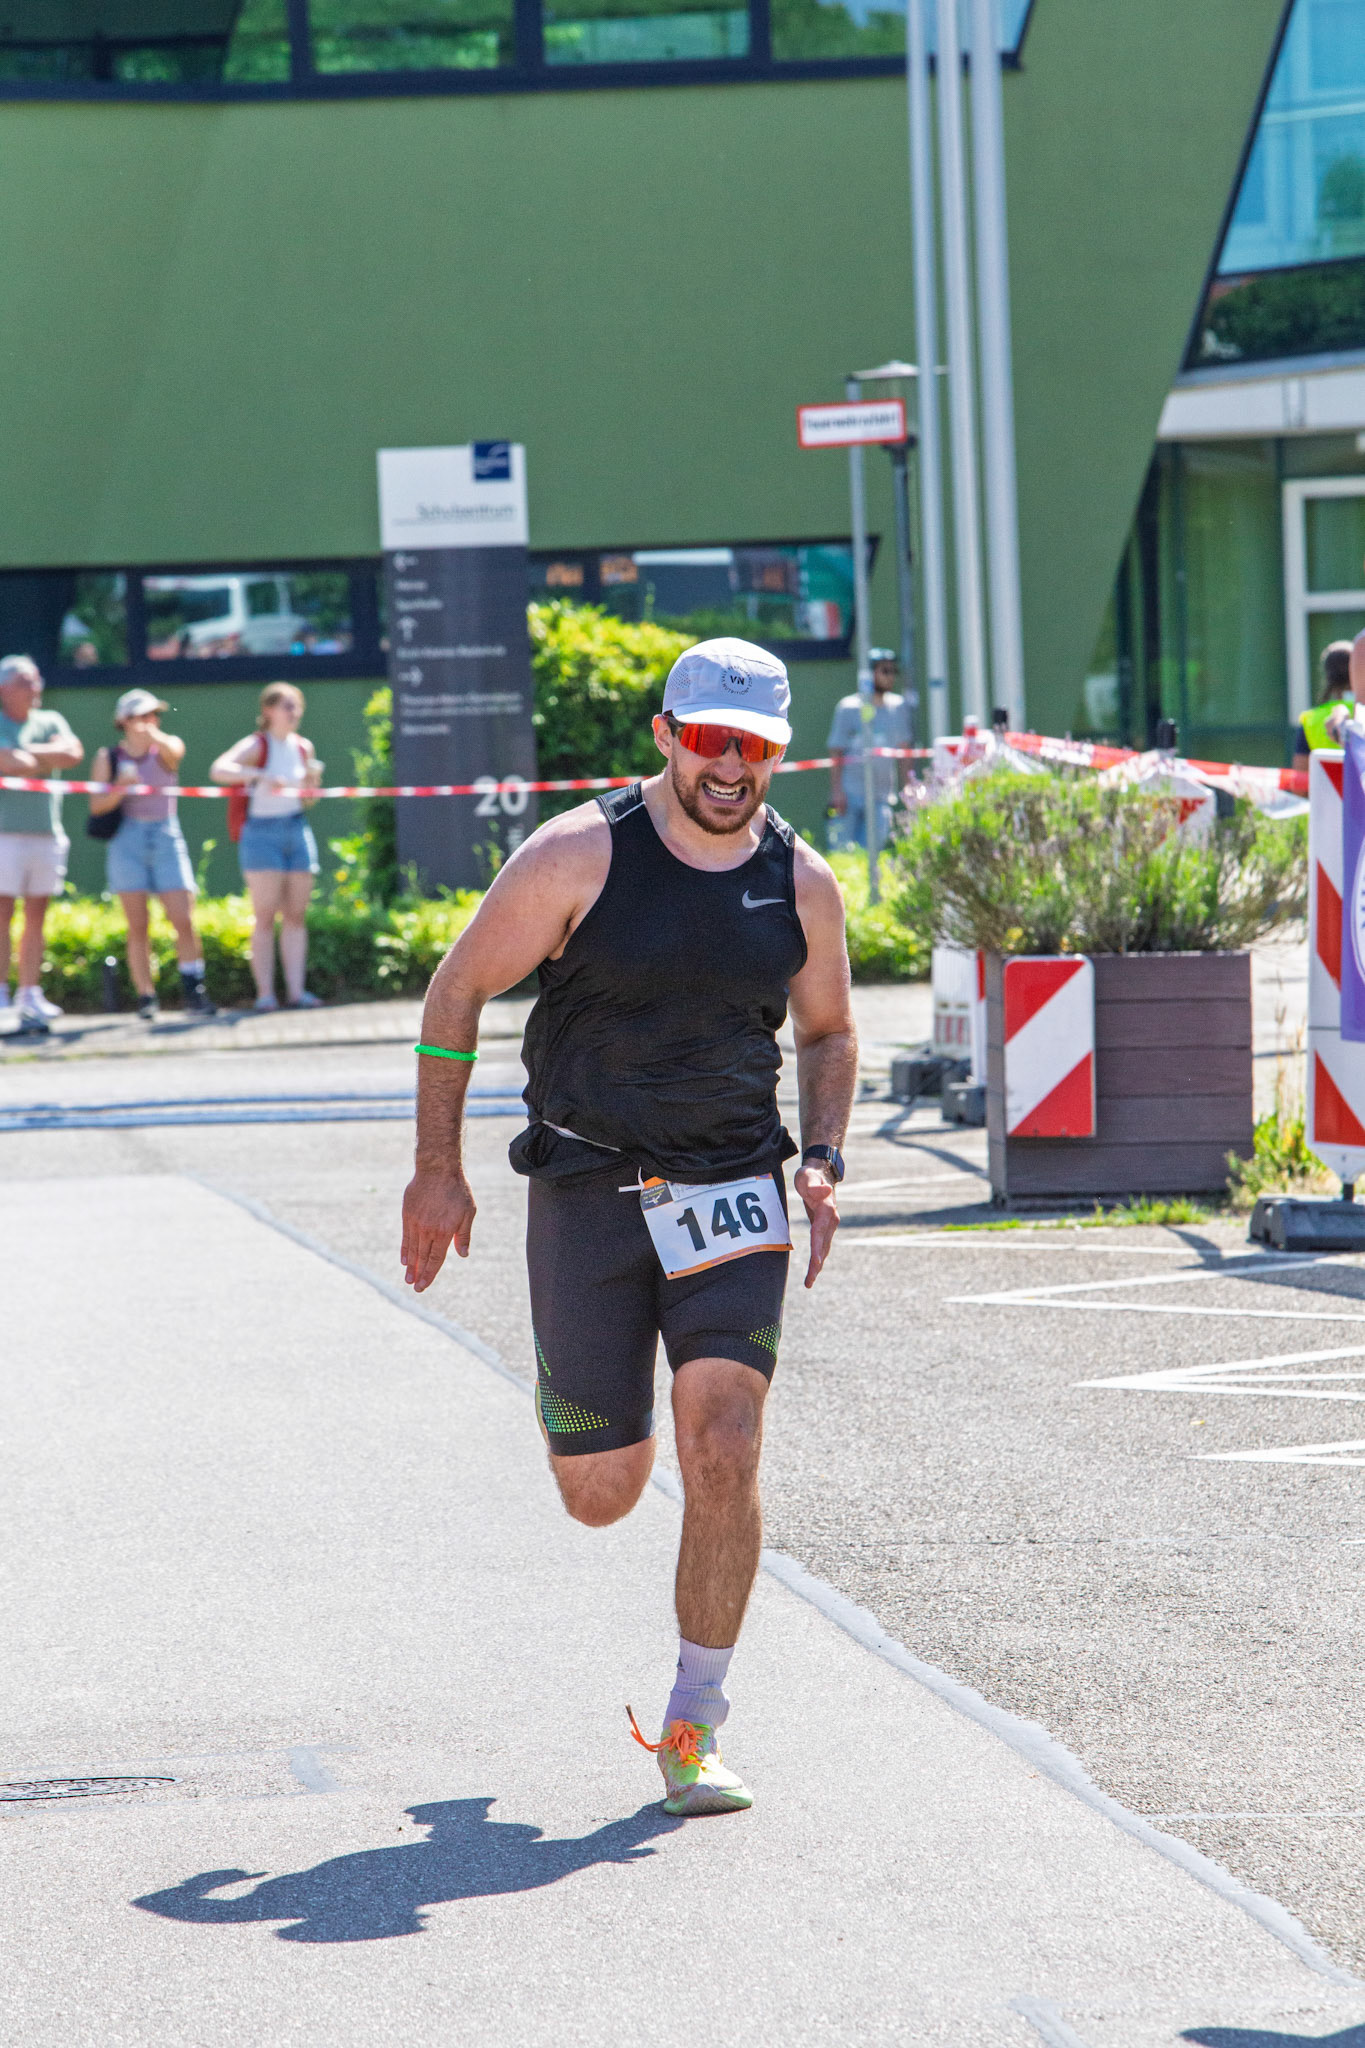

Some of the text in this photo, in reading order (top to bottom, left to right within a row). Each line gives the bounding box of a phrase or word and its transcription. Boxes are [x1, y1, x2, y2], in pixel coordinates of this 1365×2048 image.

[729, 675, 745, 685] VN
[472, 774, 529, 817] 20
[676, 1191, 769, 1252] 146
